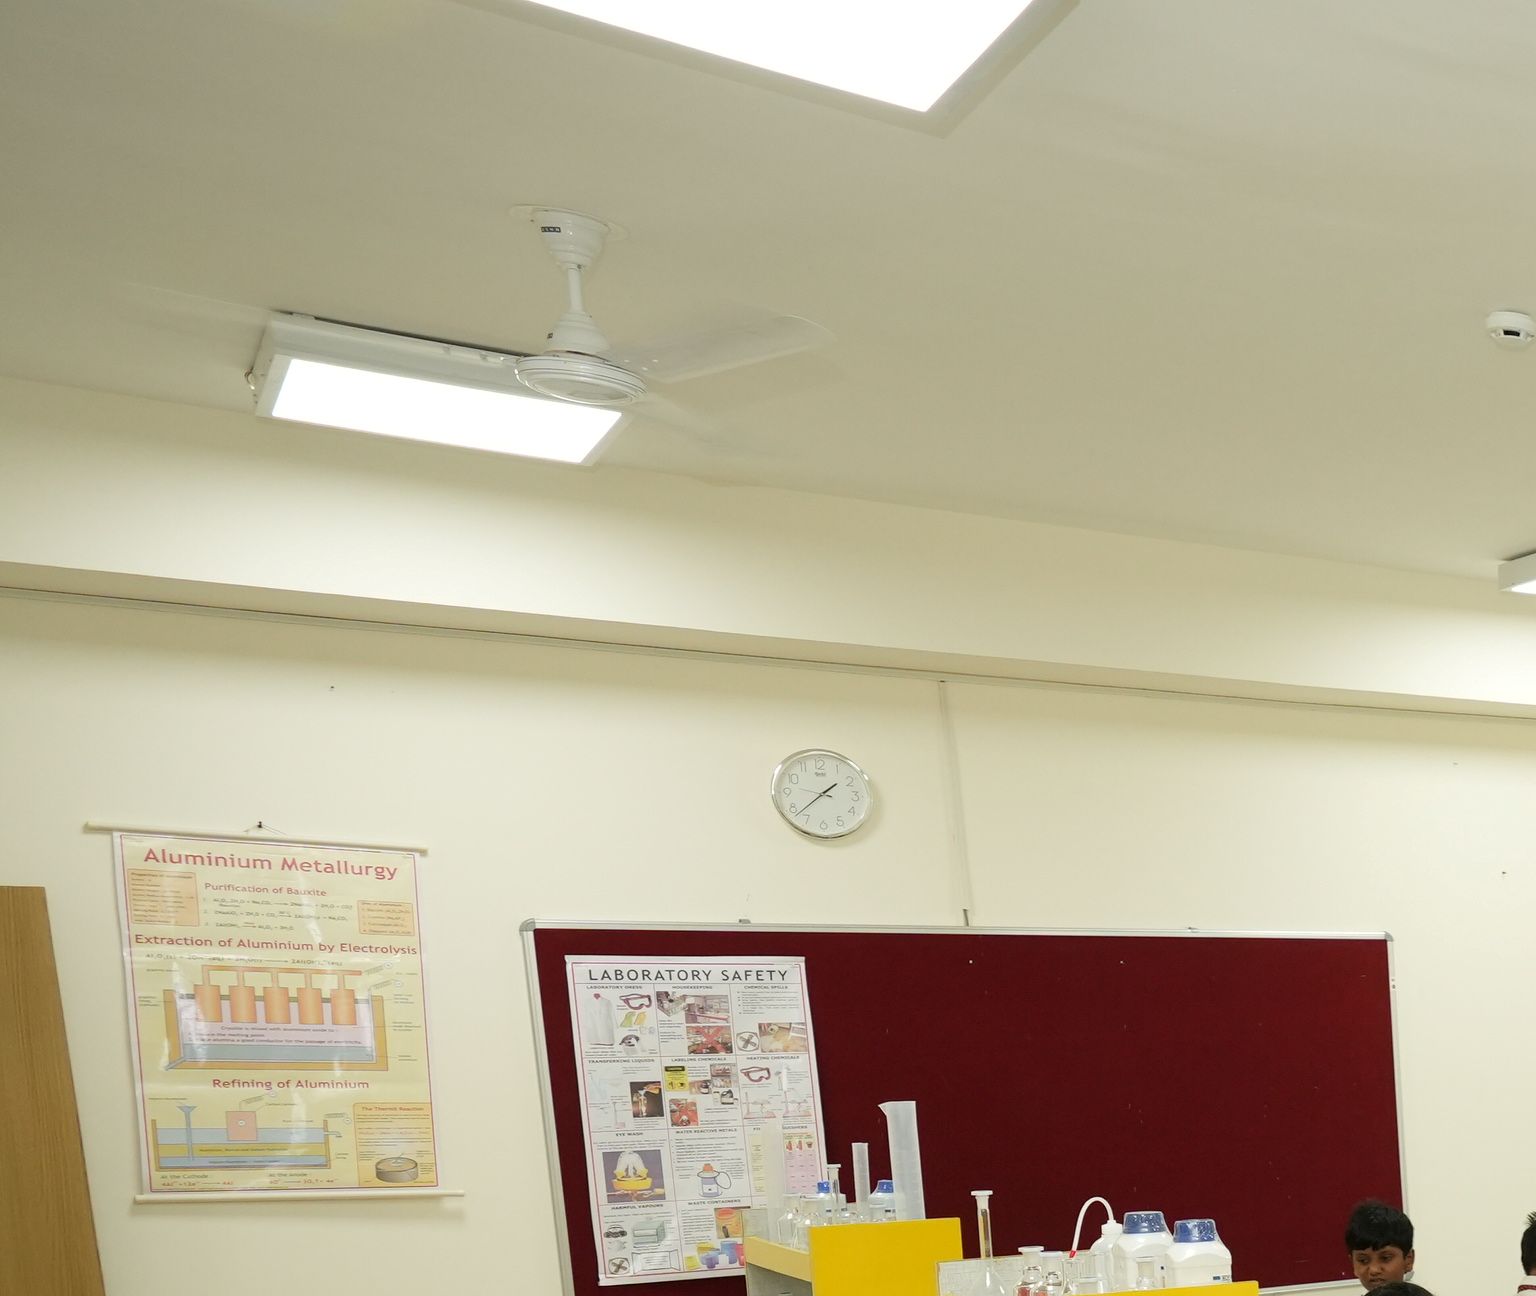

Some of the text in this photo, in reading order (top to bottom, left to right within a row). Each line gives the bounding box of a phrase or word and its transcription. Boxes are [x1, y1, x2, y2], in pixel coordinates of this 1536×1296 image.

[798, 761, 806, 772] 11
[815, 758, 825, 770] 12
[835, 763, 839, 775] 1
[788, 773, 798, 784] 10
[846, 776, 853, 787] 2
[783, 788, 791, 797] 9
[851, 791, 859, 801] 3
[789, 803, 797, 813] 8
[848, 806, 855, 816] 4
[802, 814, 810, 824] 7
[836, 816, 844, 826] 5
[820, 821, 828, 830] 6
[144, 848, 398, 880] Aluminium Metallurgy
[204, 883, 327, 897] Purification of Bauxite
[135, 934, 417, 955] Extraction of Aluminium by Electrolysis
[588, 969, 788, 981] LABORATORY SAFETY
[213, 1079, 369, 1090] Refining of Aluminium
